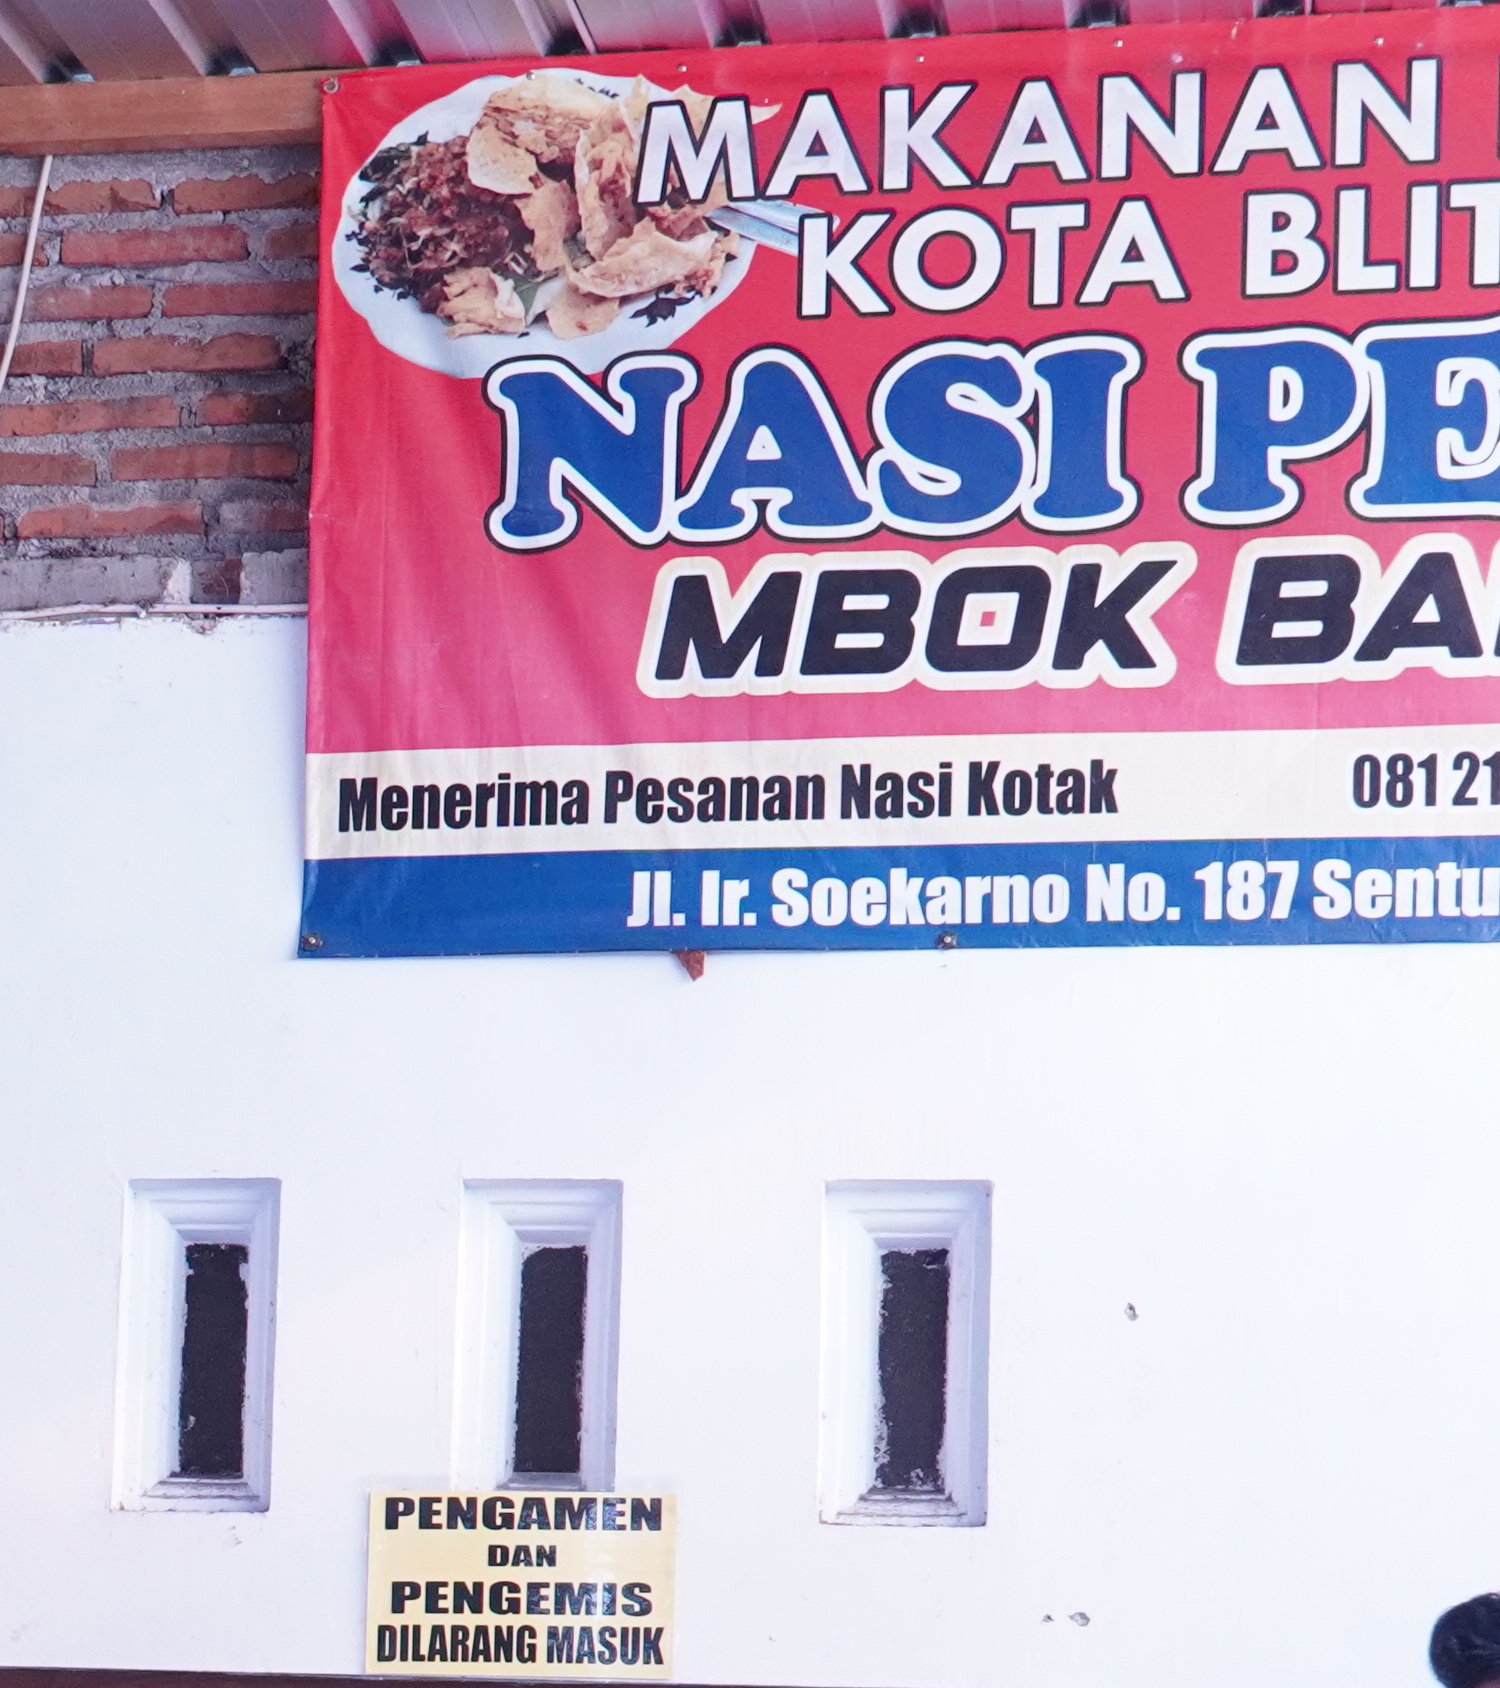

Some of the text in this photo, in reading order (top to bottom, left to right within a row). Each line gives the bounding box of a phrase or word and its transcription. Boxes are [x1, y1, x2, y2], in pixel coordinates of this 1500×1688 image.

[635, 55, 1443, 203] MAKANAN
[798, 194, 1189, 317] KOTA
[487, 336, 1141, 546] NASI
[670, 558, 1179, 680] MBOK
[337, 758, 1119, 833] Menerima Pesanan Nasi Kotak
[1352, 752, 1438, 808] 081
[626, 872, 686, 928] Jl.
[700, 870, 757, 928] Ir.
[771, 867, 1070, 926] Soekarno
[1085, 863, 1181, 922] No.
[1194, 860, 1296, 921] 187
[384, 1496, 662, 1531] PENGAMEN
[488, 1544, 557, 1567] DAN
[391, 1581, 653, 1616] PENGEMIS
[377, 1624, 665, 1665] DILARANG MASUK
